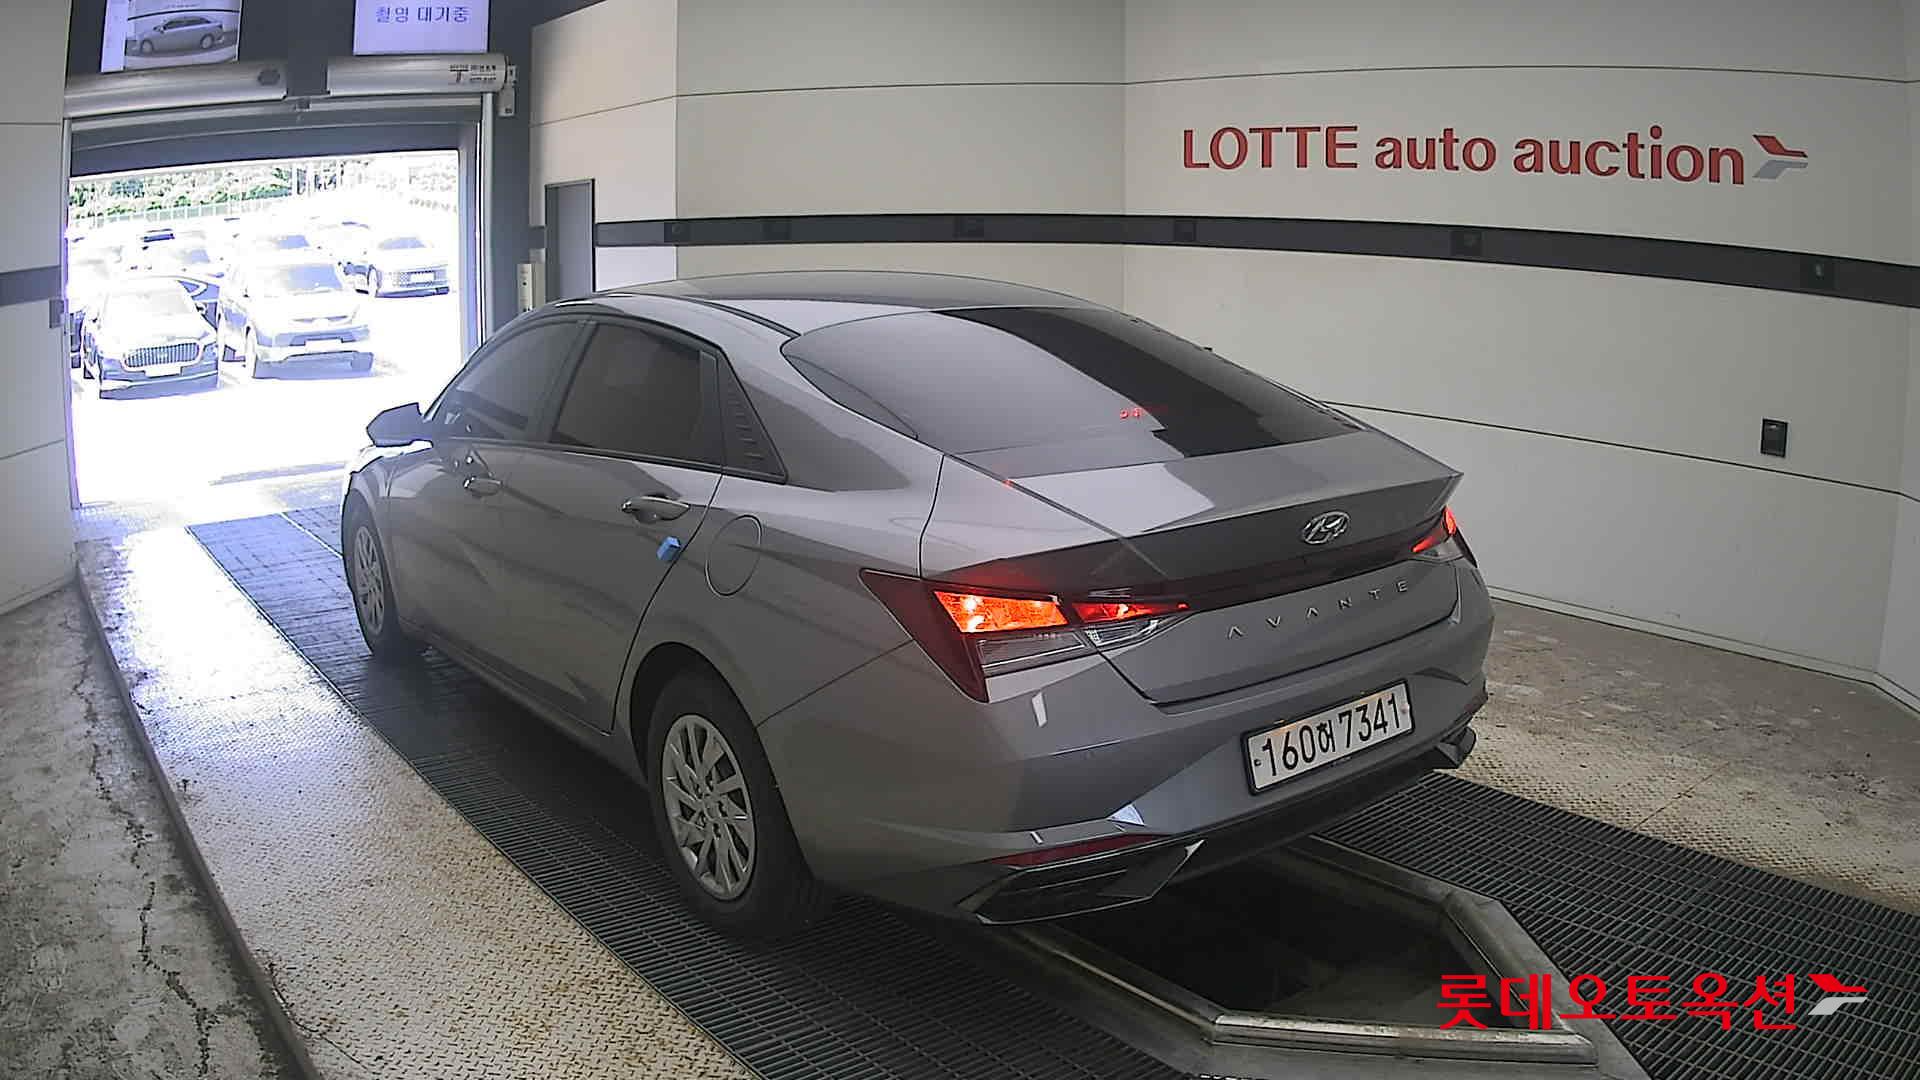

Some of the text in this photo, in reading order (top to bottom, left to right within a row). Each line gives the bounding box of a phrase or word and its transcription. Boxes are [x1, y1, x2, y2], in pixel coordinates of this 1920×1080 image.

[417, 6, 471, 23] 대기중
[1183, 124, 1745, 185] LOTTE auto auction
[1228, 580, 1409, 640] AVANTE
